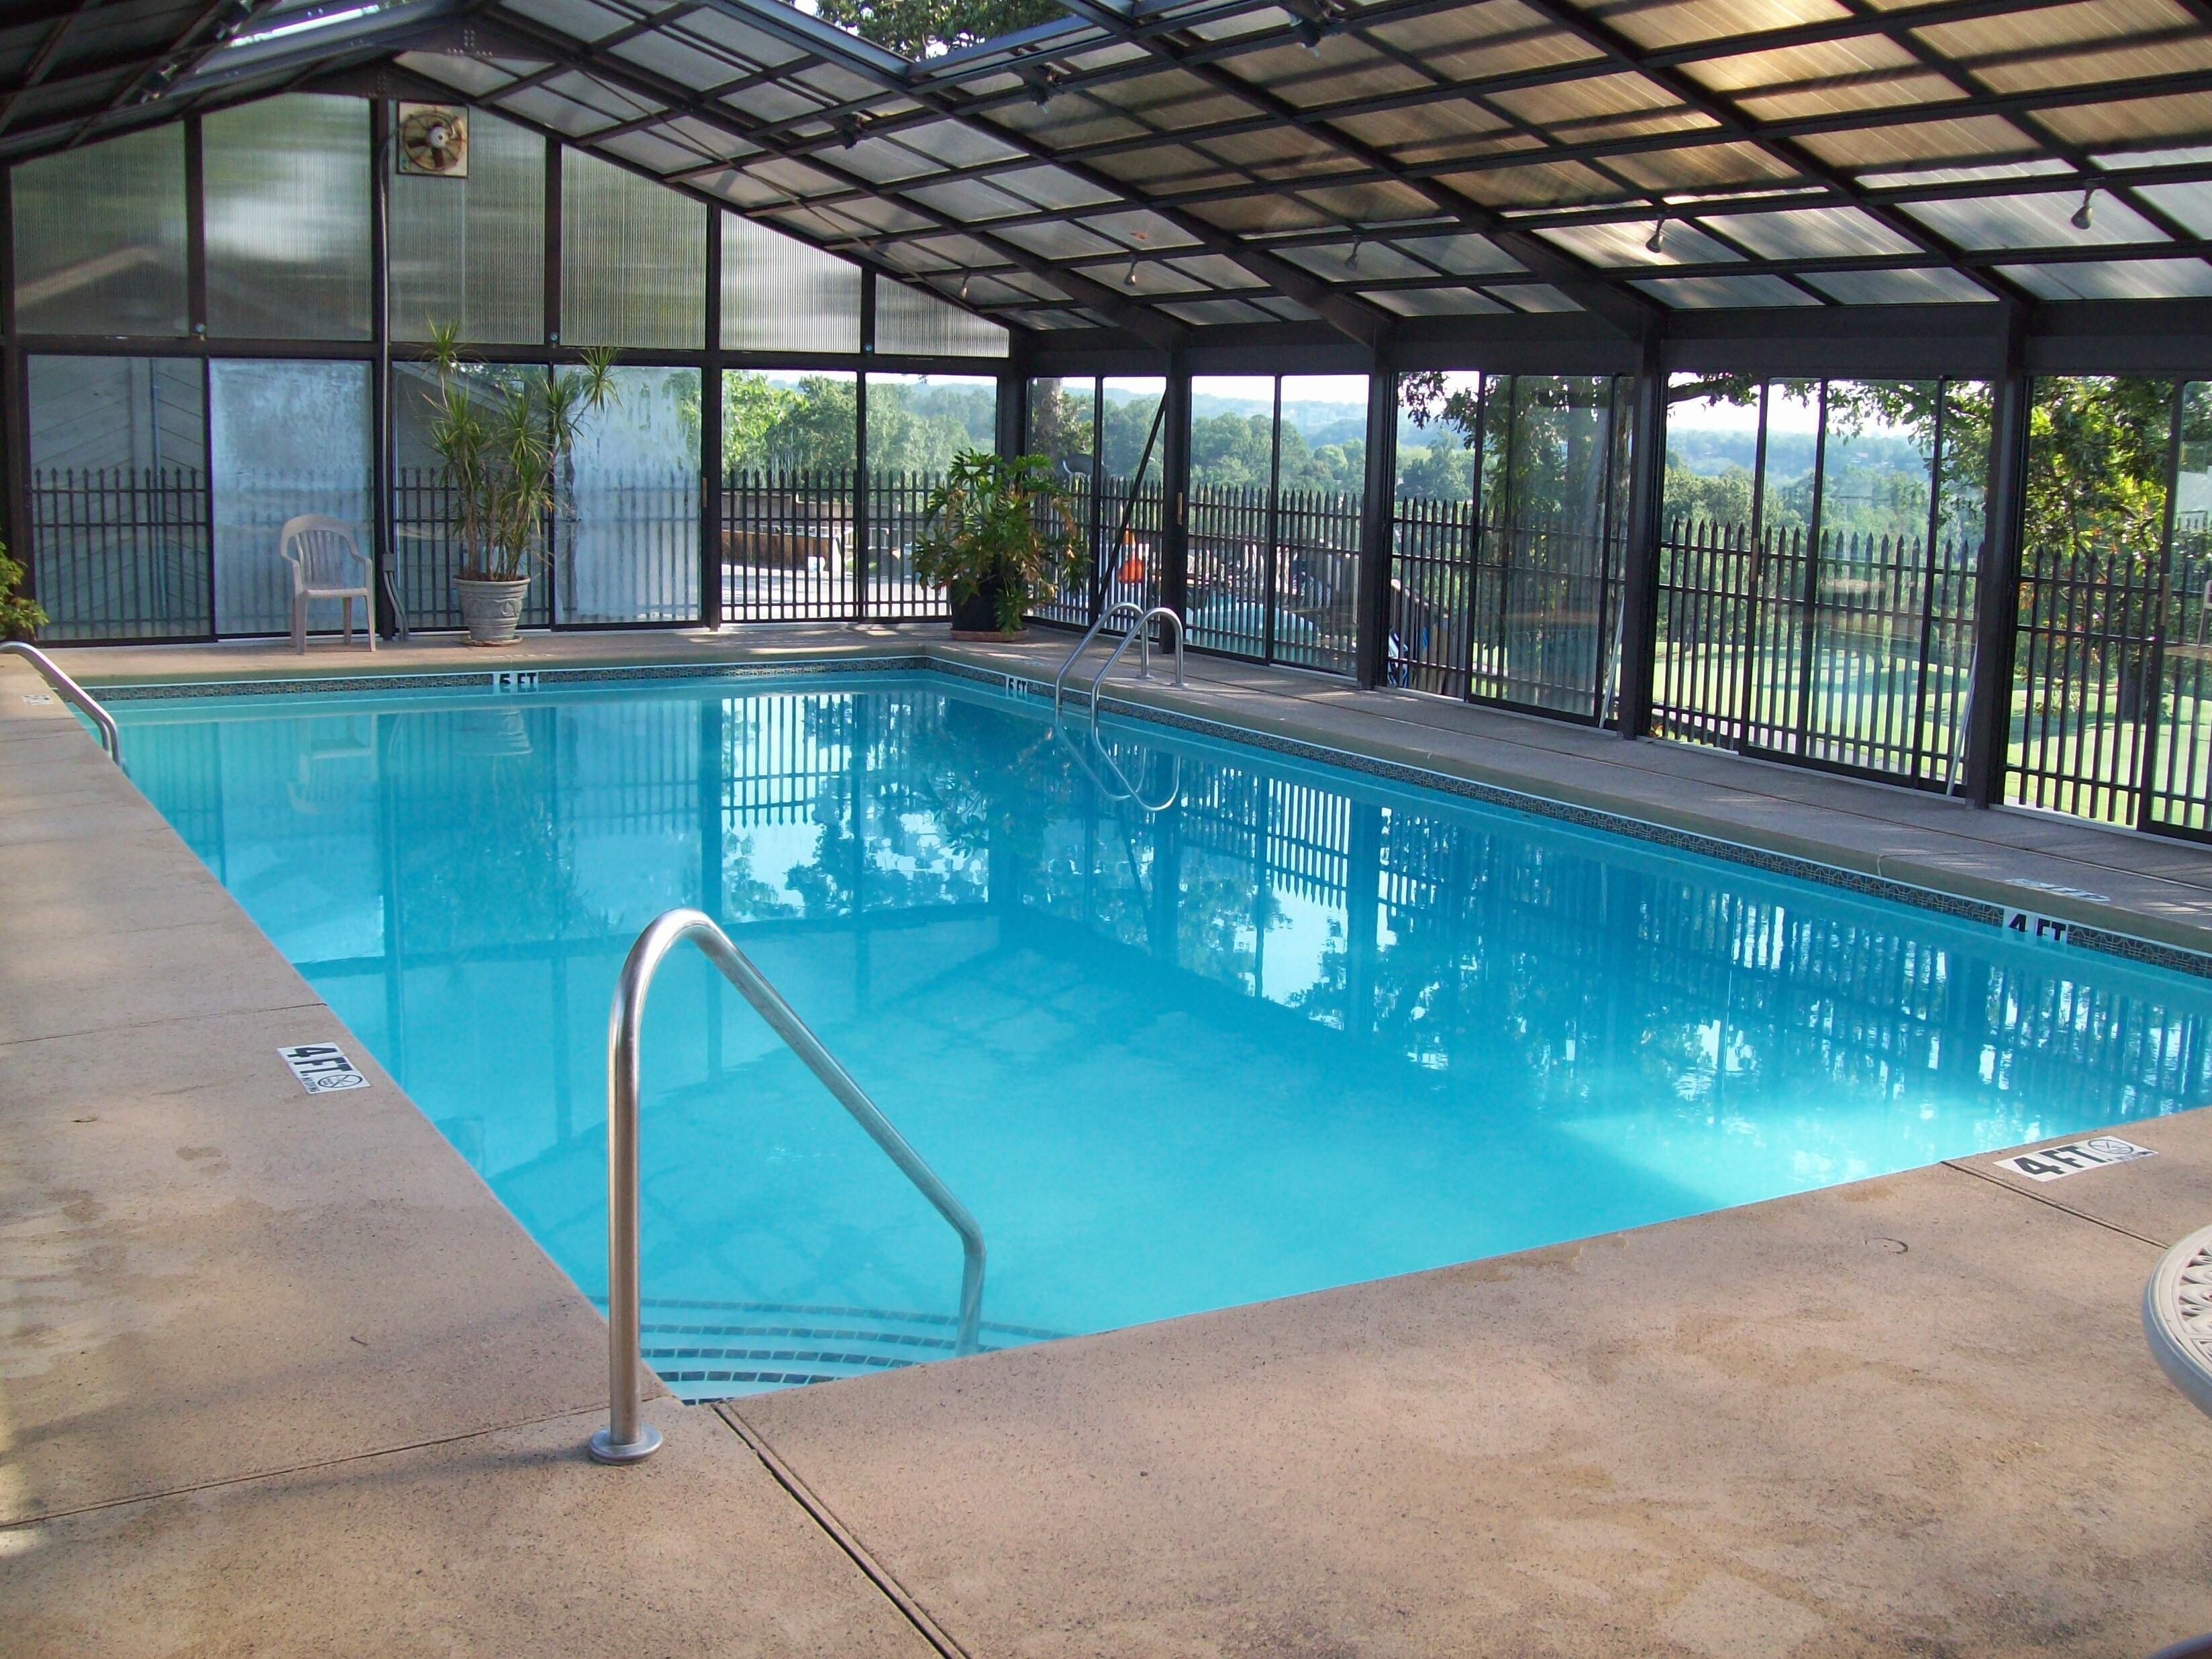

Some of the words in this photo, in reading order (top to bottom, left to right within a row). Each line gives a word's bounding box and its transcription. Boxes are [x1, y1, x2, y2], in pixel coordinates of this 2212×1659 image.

[2008, 913, 2027, 932] 4
[2036, 917, 2066, 941] FT
[287, 1047, 338, 1058] 4
[2013, 1156, 2068, 1175] 4
